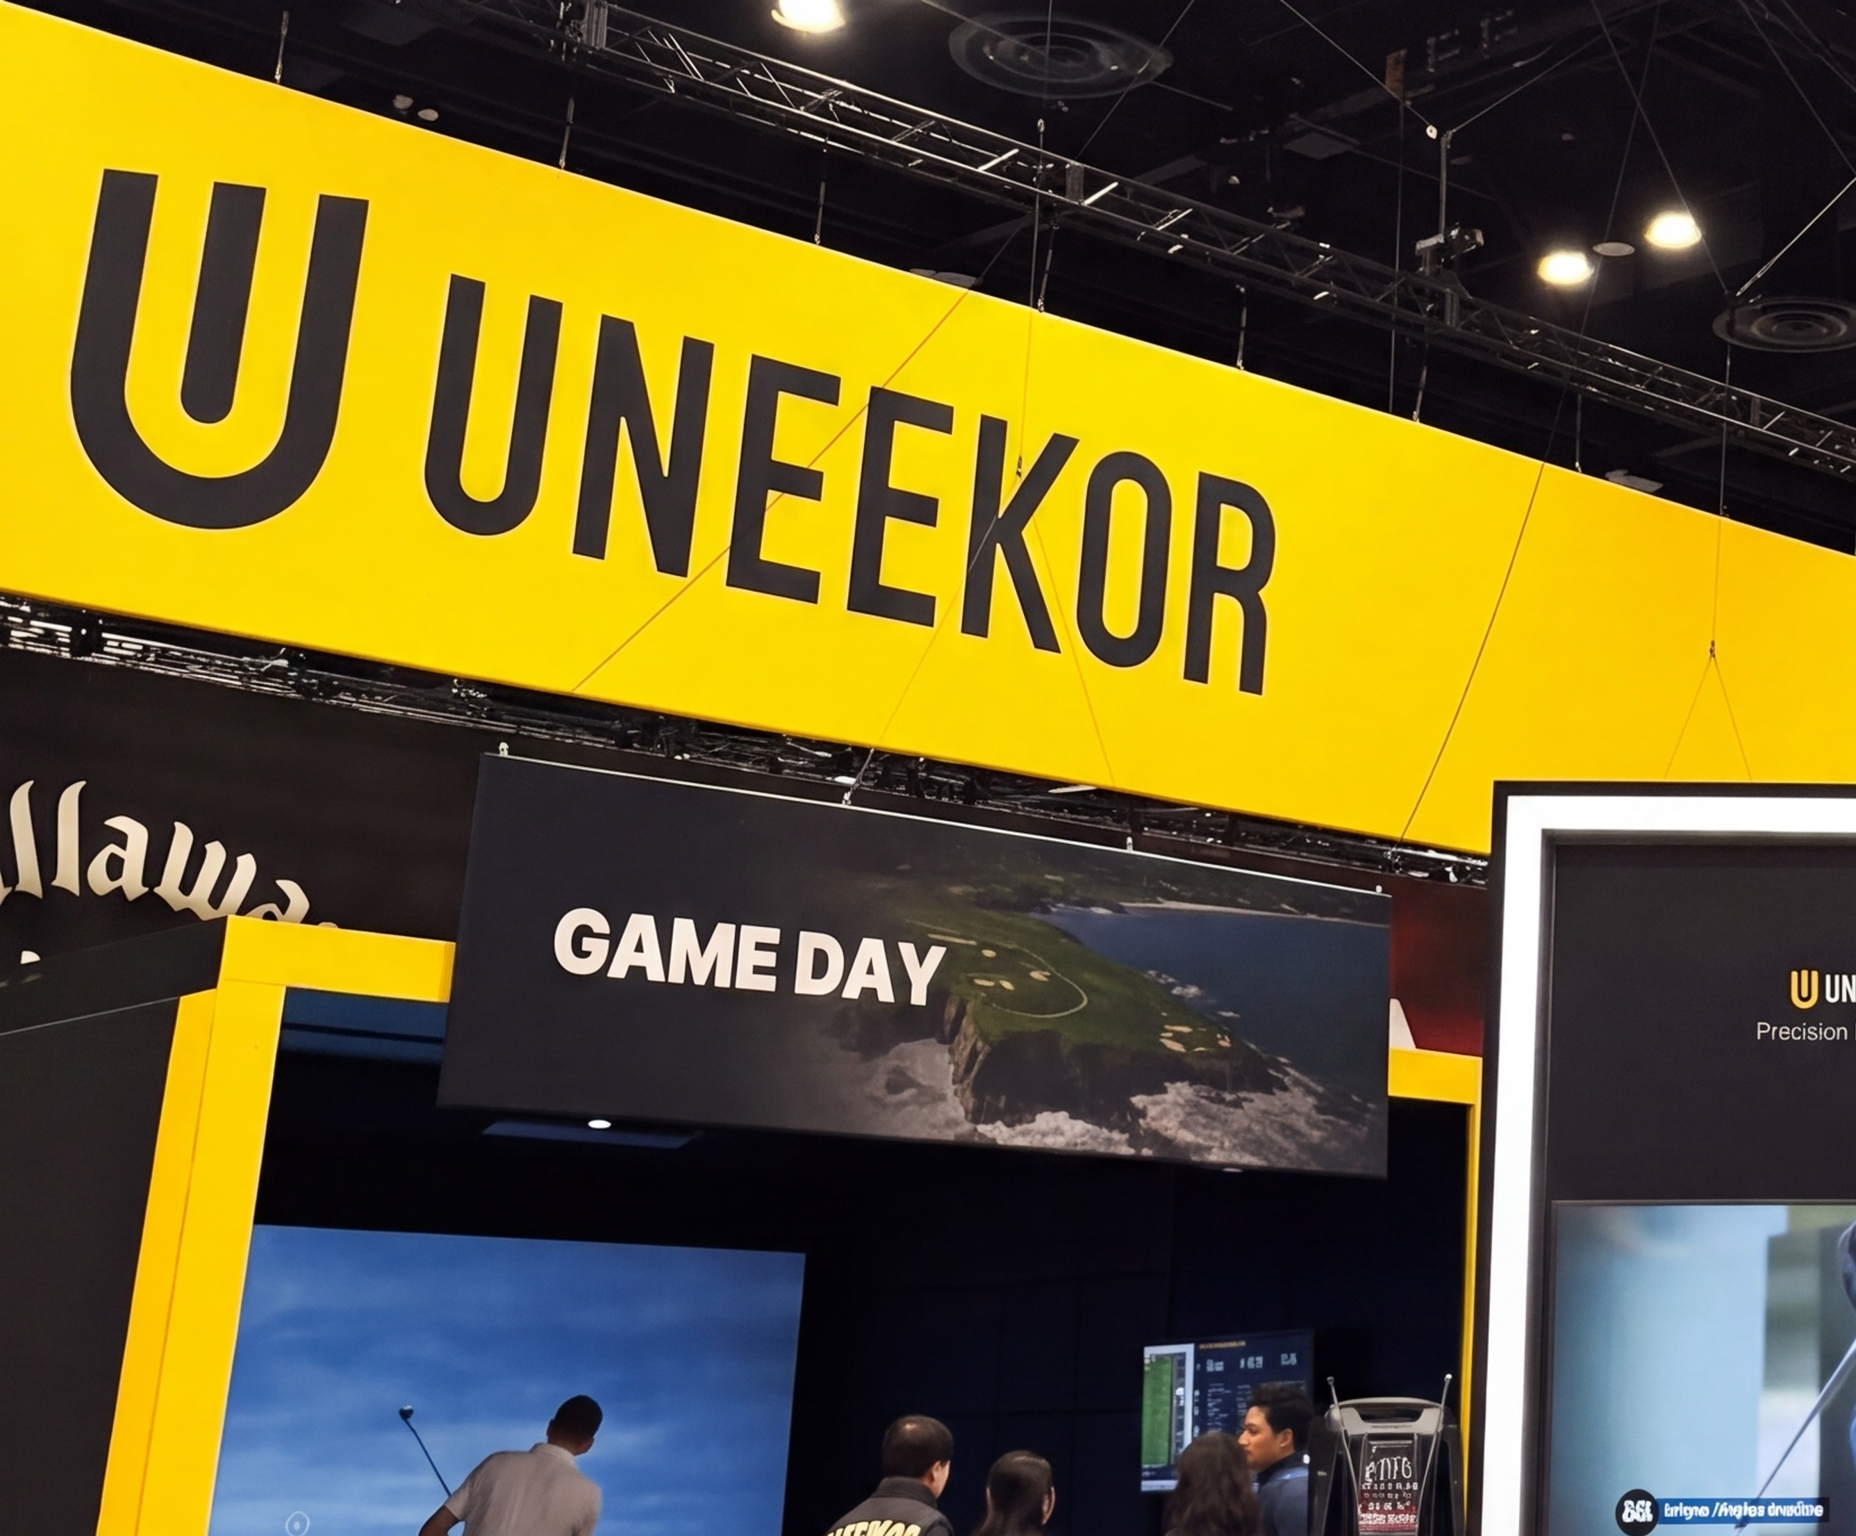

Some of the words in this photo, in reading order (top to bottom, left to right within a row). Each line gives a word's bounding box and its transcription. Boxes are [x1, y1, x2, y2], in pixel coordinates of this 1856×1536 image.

[424, 273, 1276, 697] UNEEKOR
[553, 907, 781, 993] GAME
[794, 930, 948, 1006] DAY
[1756, 1021, 1849, 1042] Precision
